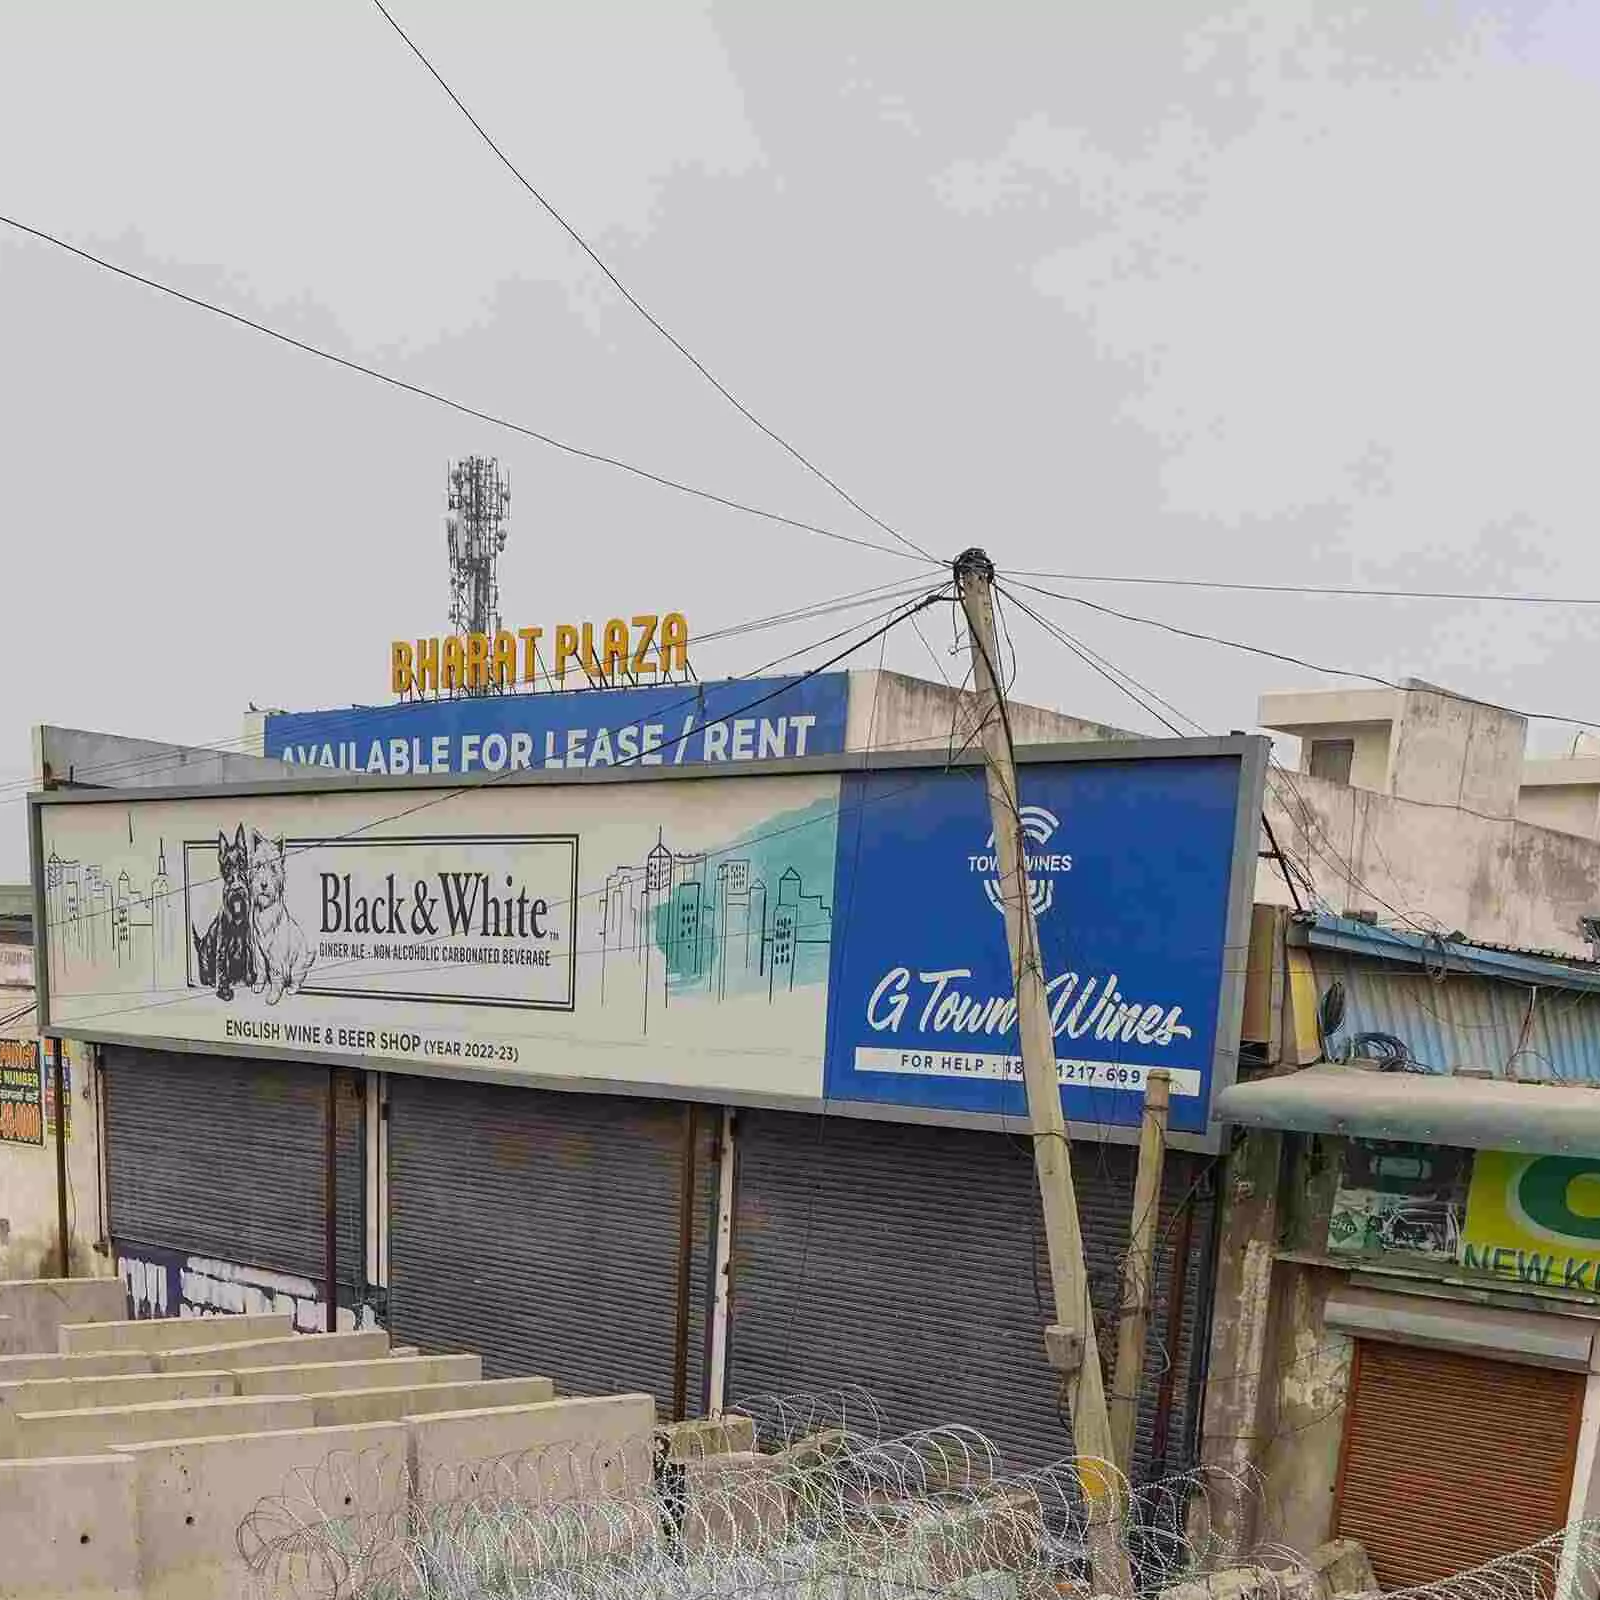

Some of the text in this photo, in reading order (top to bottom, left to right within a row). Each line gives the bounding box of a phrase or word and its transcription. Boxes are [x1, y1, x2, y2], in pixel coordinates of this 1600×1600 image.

[390, 611, 690, 695] BHARAT PLAZA
[460, 732, 534, 773] FOR
[545, 723, 663, 770] LEASE
[703, 714, 817, 762] RENT
[319, 942, 349, 959] GINGER
[350, 944, 365, 960] ALE
[441, 946, 499, 965] CARBONATED
[502, 949, 551, 967] BEVERAGE
[866, 967, 1193, 1046] G Town Wines
[225, 1019, 520, 1063] ENGLISH WINE & BEER SHOP (YEAR 2022-23)
[3, 1070, 39, 1088] NUMBER
[901, 1054, 933, 1069] FOR
[941, 1056, 984, 1072] HELP
[1462, 1243, 1554, 1284] NEW
